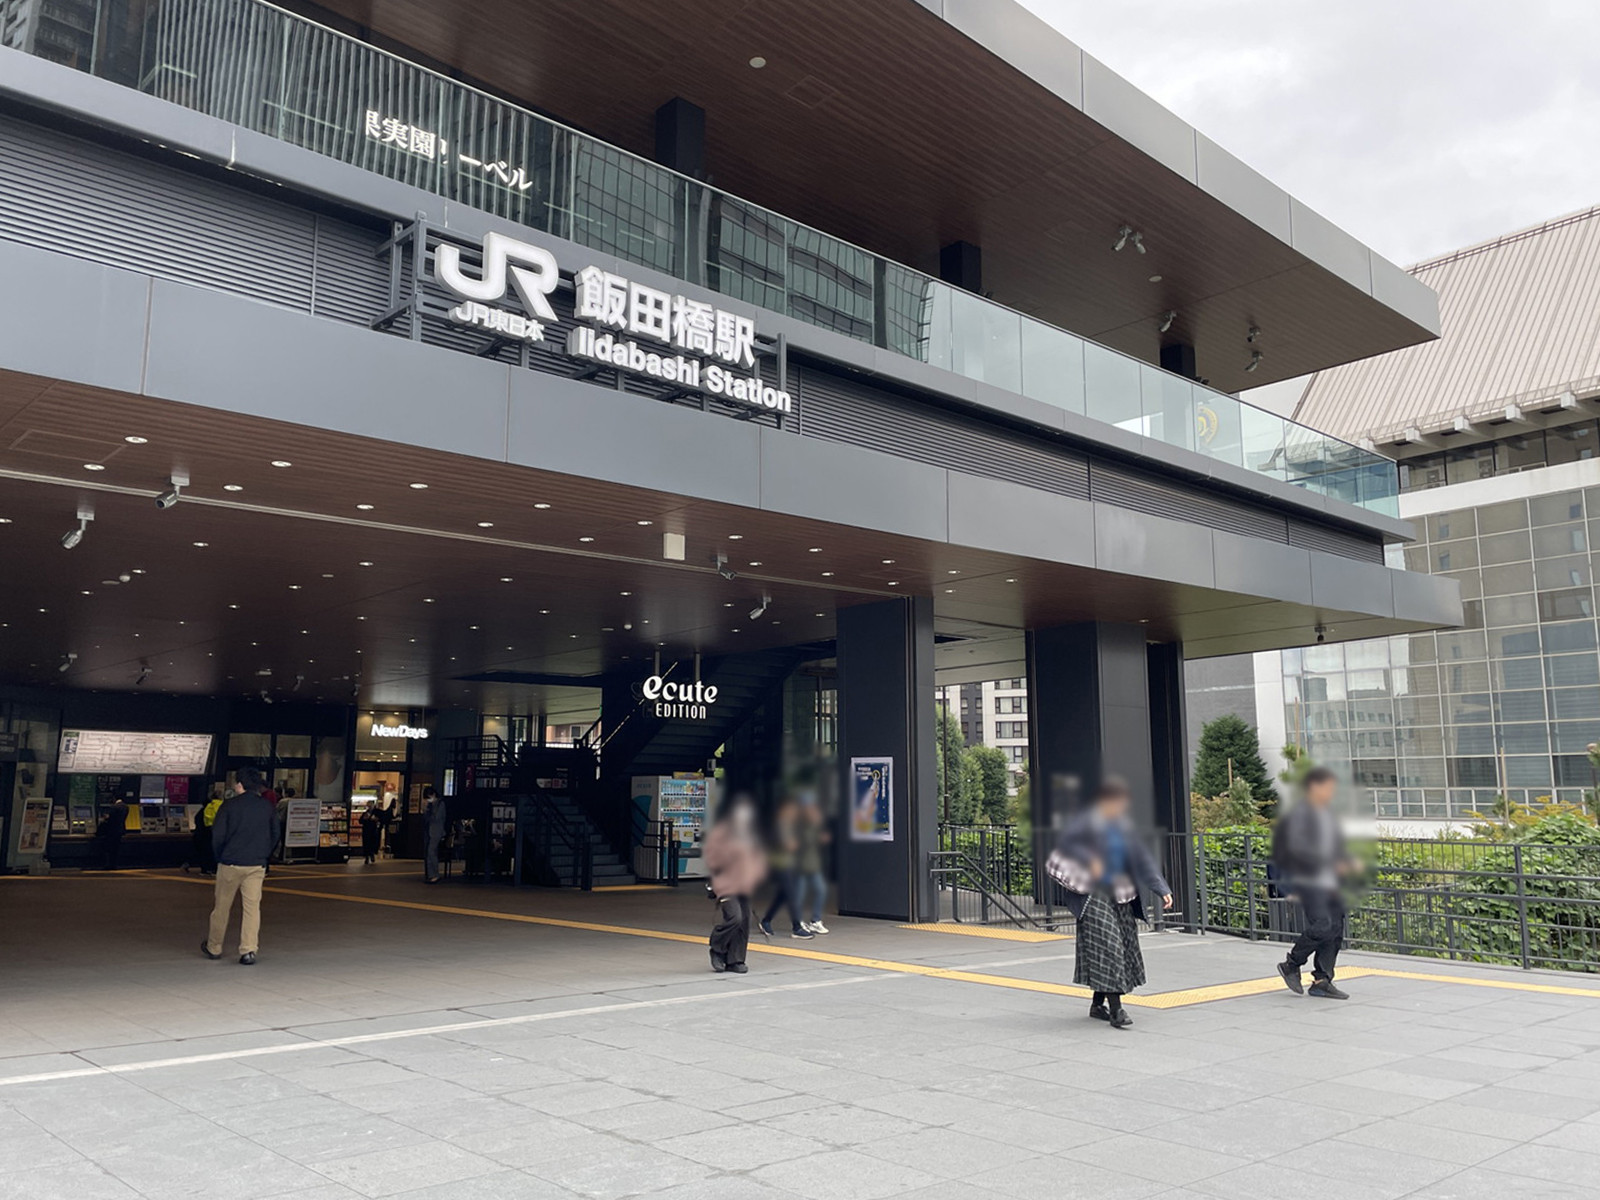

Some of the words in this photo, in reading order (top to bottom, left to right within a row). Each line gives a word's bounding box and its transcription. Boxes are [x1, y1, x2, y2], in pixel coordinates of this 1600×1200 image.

[434, 232, 559, 322] JR
[457, 302, 546, 342] JR東日本
[577, 266, 755, 367] 飯田橋駅
[578, 327, 700, 387] Iidabashi
[706, 365, 791, 413] Station
[642, 675, 719, 703] ecute
[655, 702, 707, 720] EDITION
[371, 724, 428, 740] NewDays
